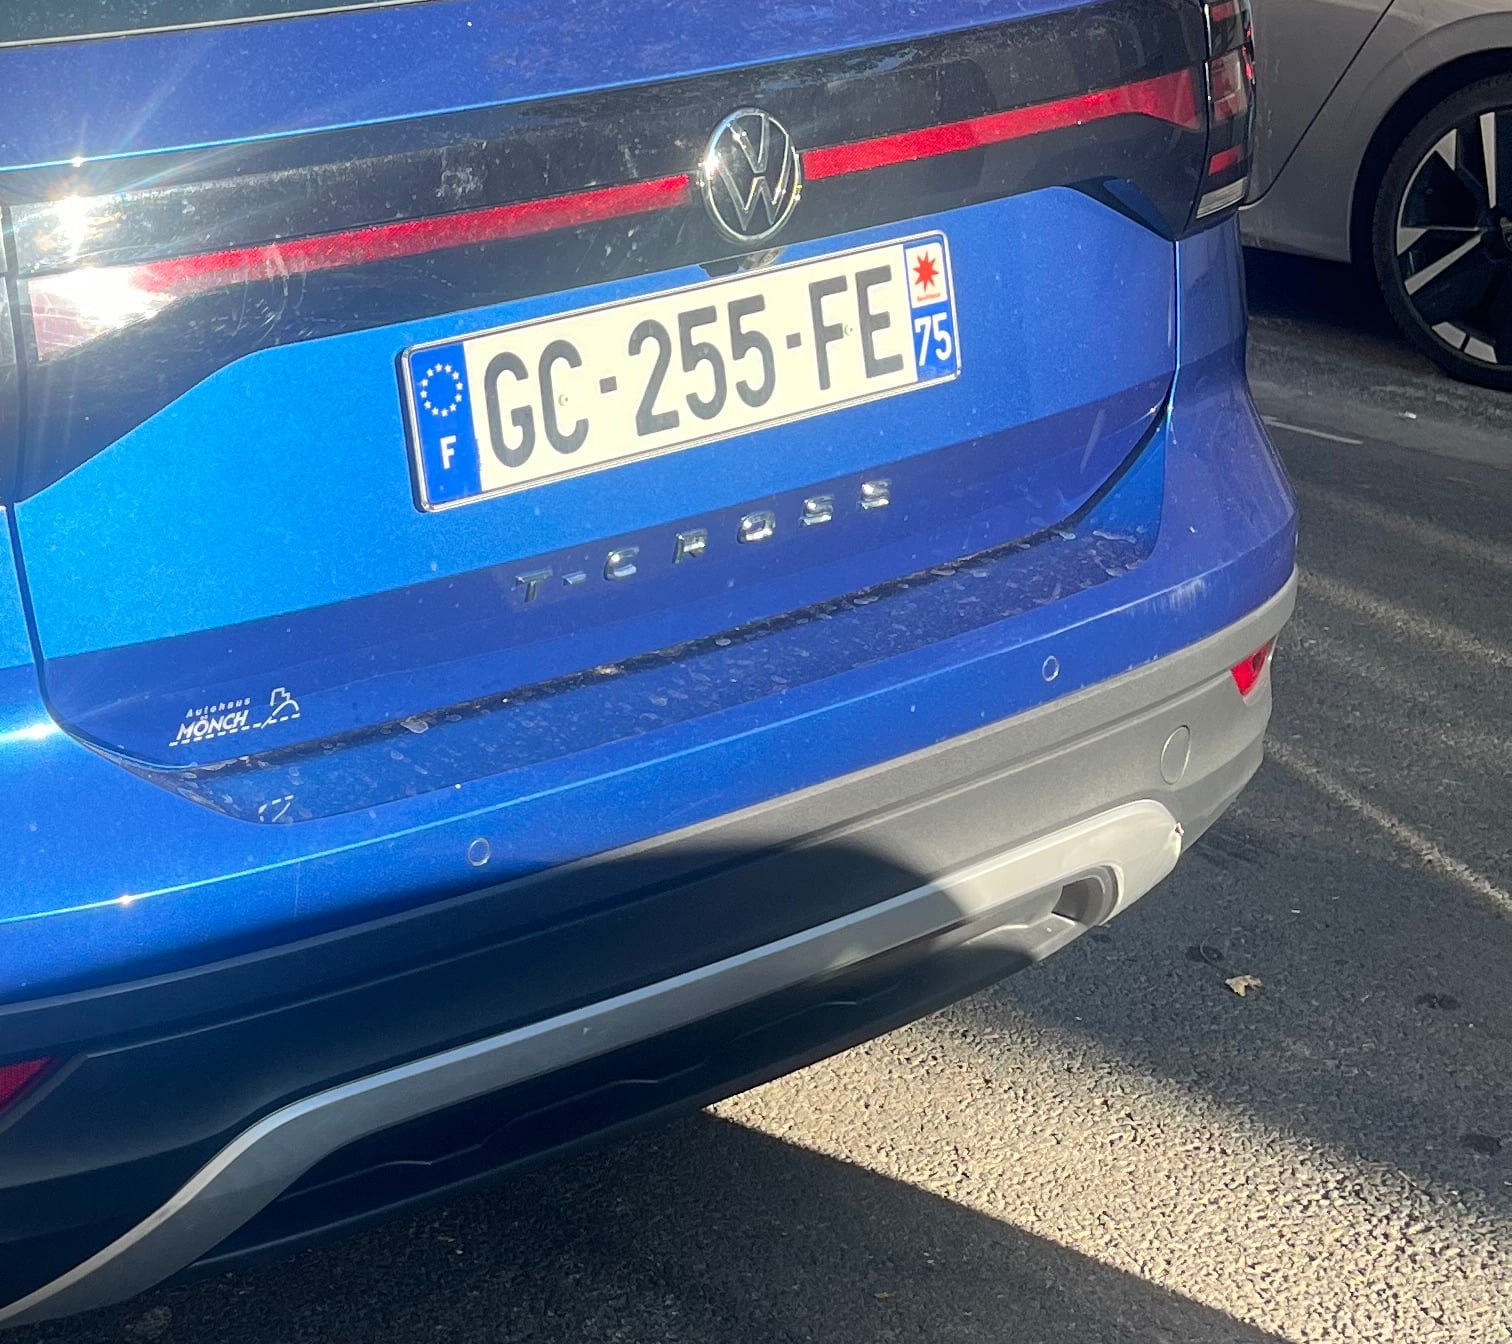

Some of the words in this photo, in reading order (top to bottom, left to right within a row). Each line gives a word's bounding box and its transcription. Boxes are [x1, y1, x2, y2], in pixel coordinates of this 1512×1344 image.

[914, 312, 952, 367] 75
[484, 264, 905, 468] GC-255-FE
[440, 435, 457, 469] F
[515, 478, 892, 603] T-CROSS
[176, 709, 249, 741] MÖNCH
[185, 697, 251, 719] Autohaus
